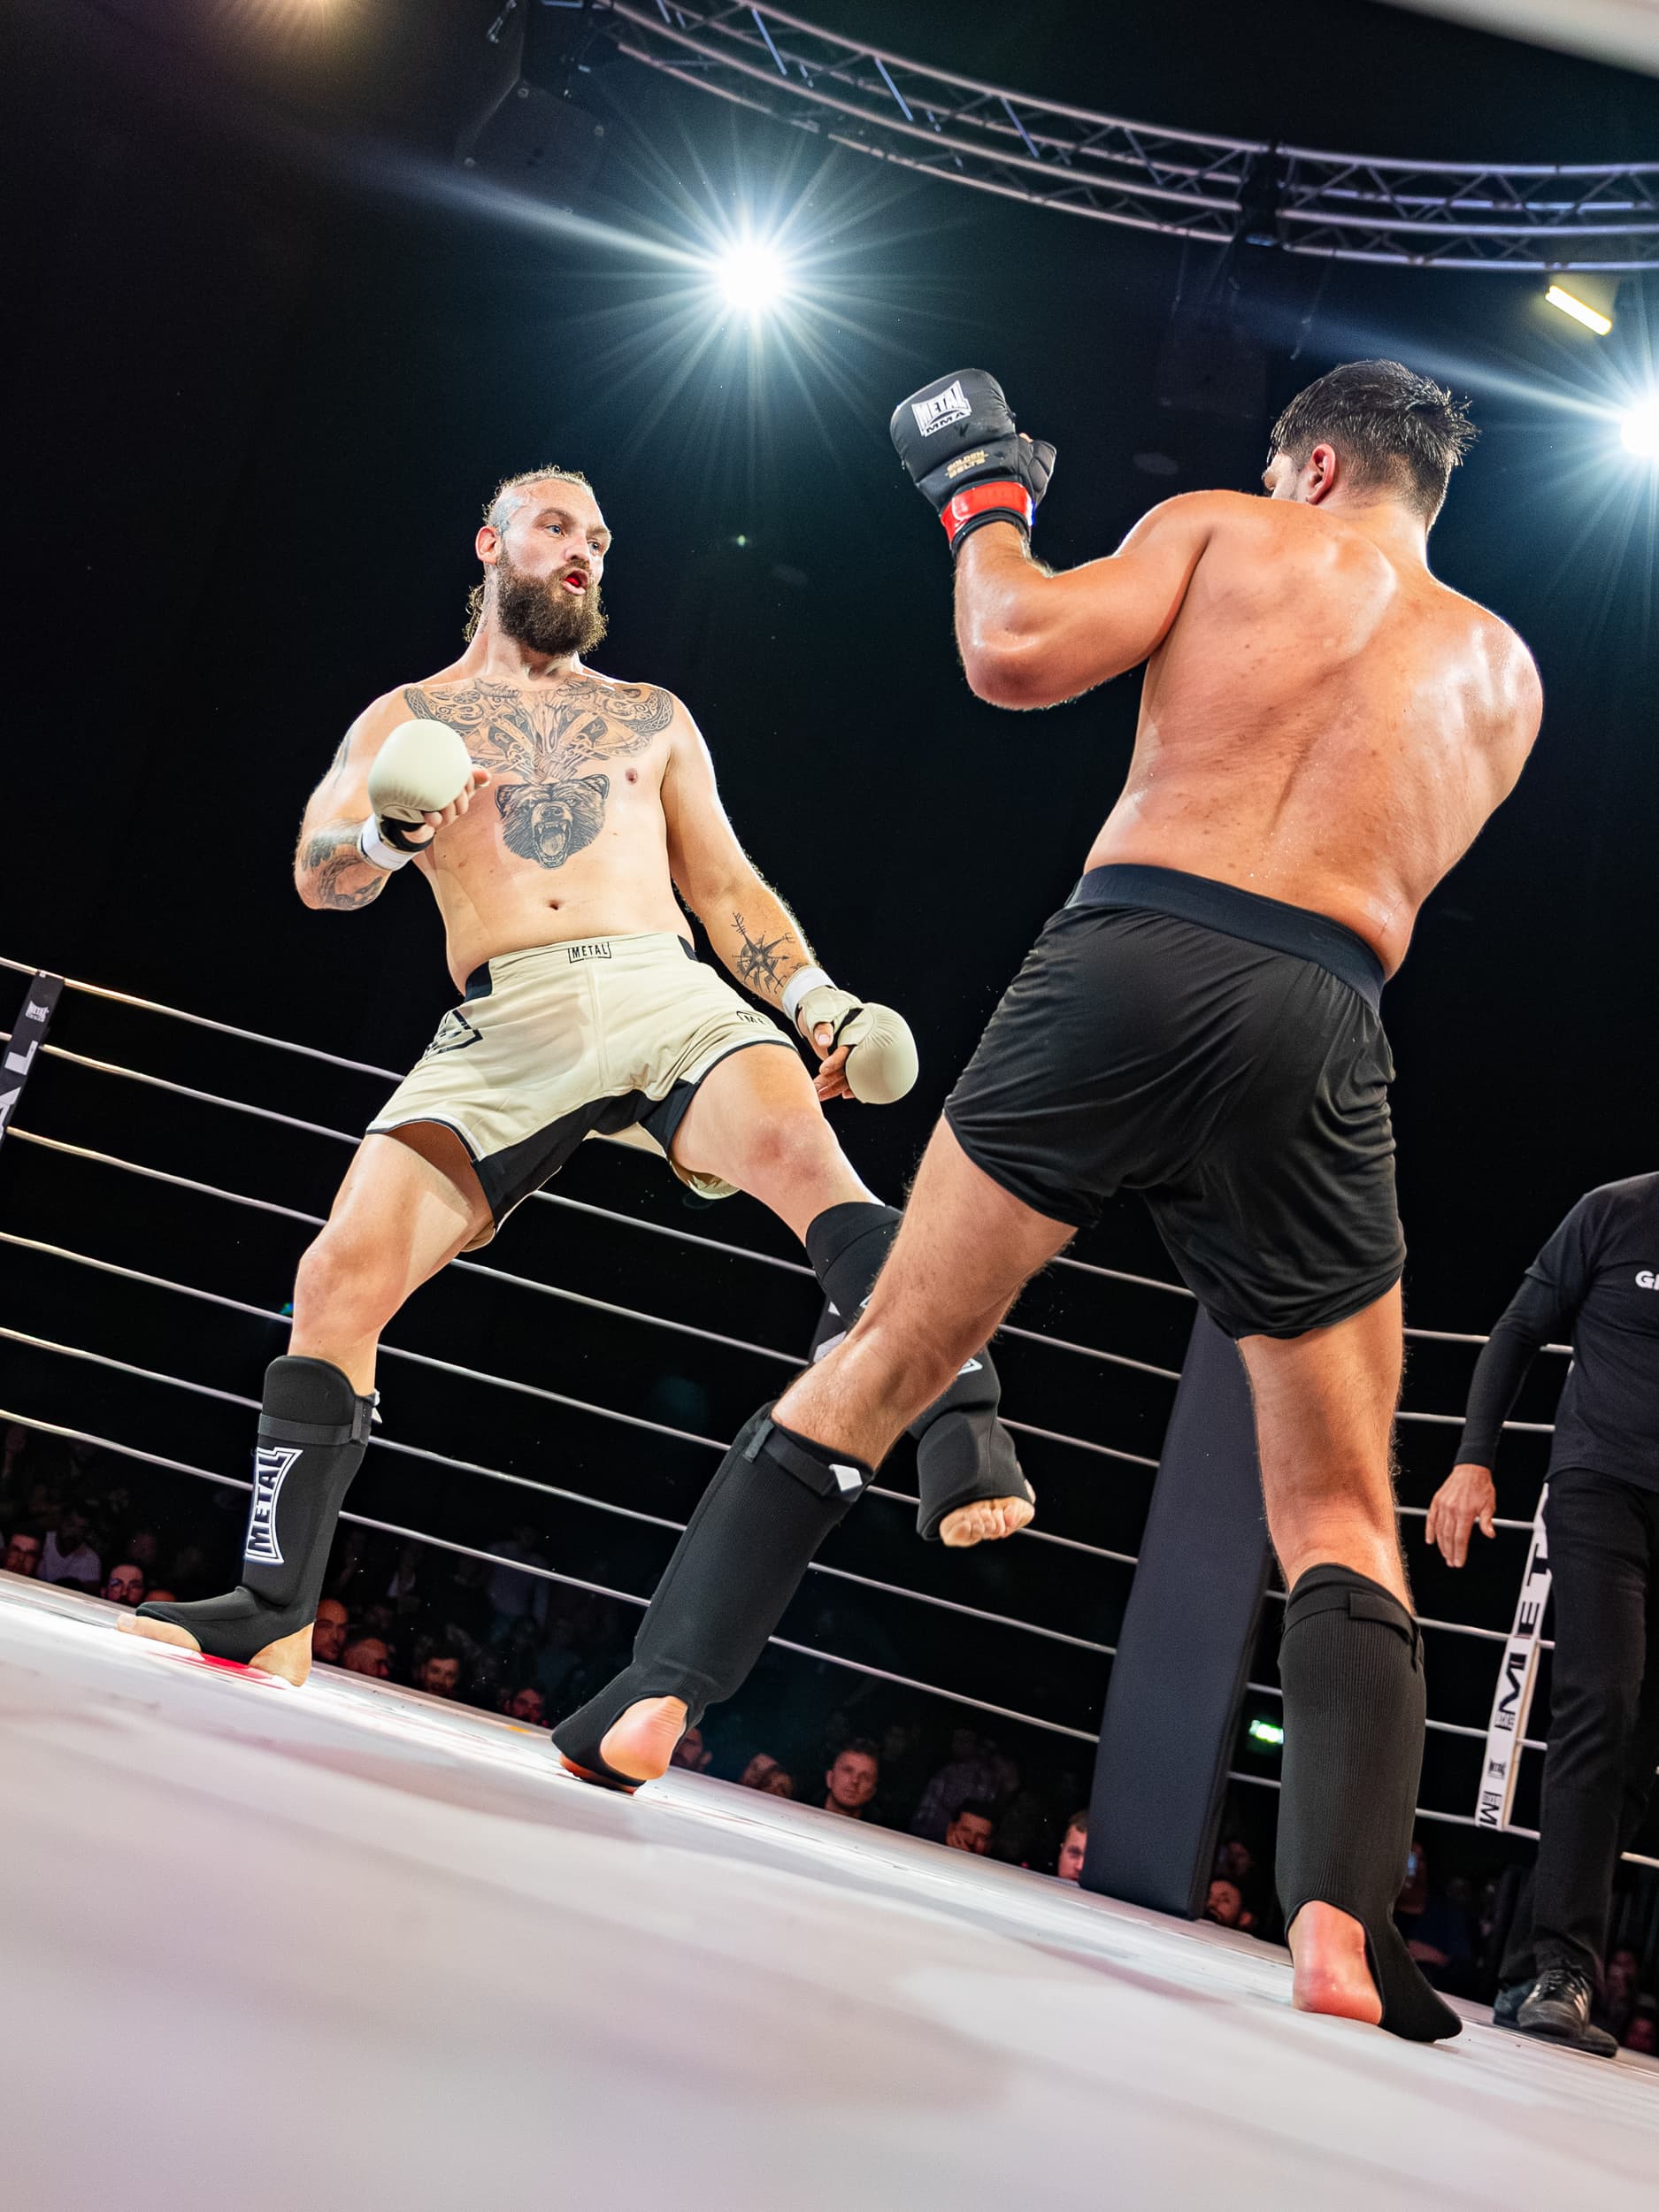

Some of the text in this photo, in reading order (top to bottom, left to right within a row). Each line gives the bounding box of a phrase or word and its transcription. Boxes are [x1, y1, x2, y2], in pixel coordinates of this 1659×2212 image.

[912, 380, 971, 434] METAL
[926, 411, 966, 434] MMA
[571, 942, 609, 959] METAL
[246, 1452, 292, 1555] METAL
